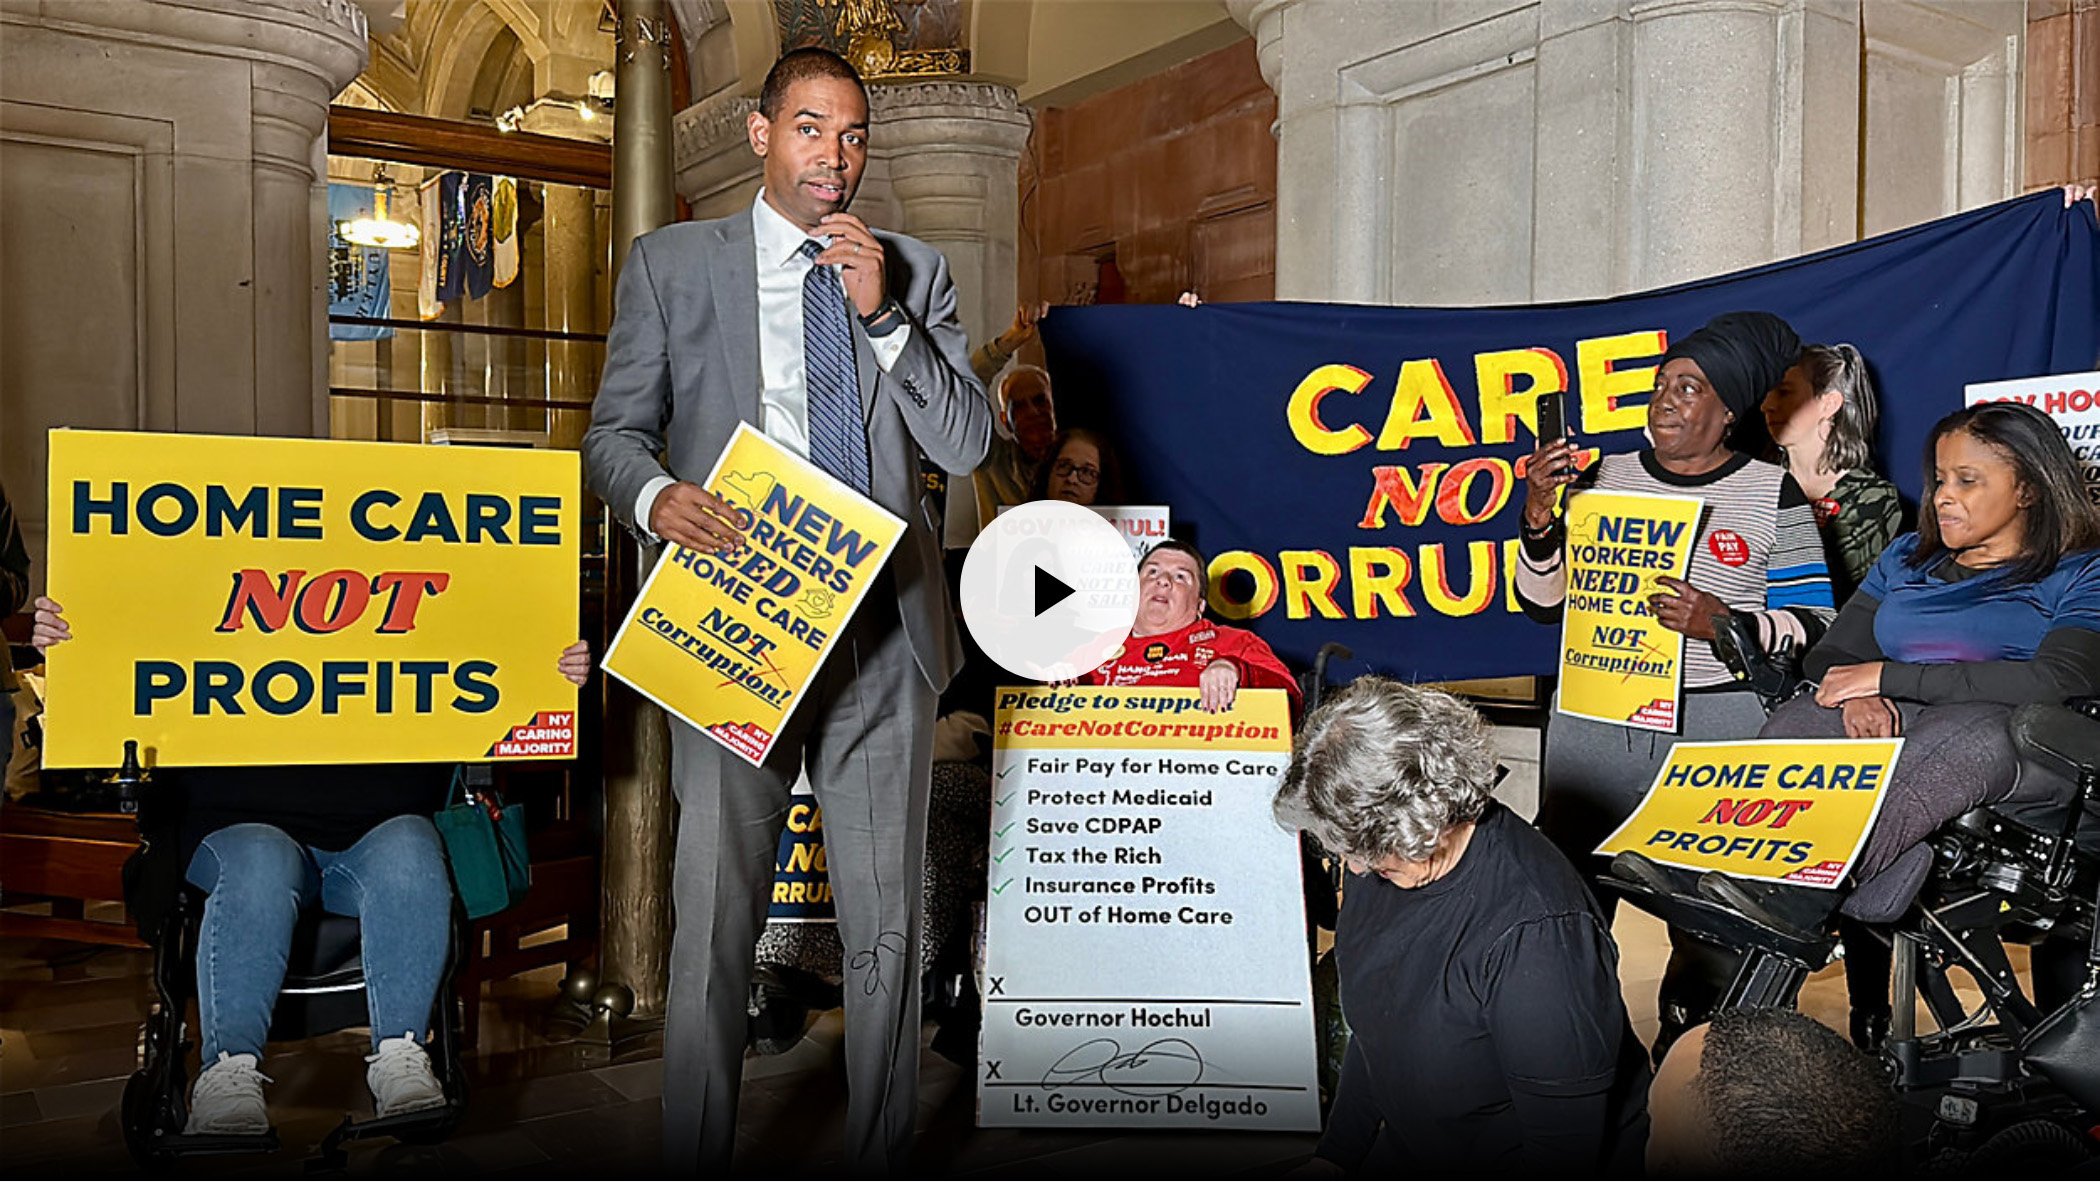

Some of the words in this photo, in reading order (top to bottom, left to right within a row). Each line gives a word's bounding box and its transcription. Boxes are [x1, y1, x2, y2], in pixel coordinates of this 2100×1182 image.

[1286, 329, 1667, 456] CARE
[72, 481, 324, 539] HOME
[350, 490, 561, 545] CARE
[762, 483, 878, 569] NEW
[1597, 515, 1687, 547] NEW
[1714, 533, 1736, 541] FAIR
[715, 490, 853, 594] ORKERS
[1717, 542, 1738, 551] PAY
[1570, 545, 1675, 570] YORKERS
[713, 543, 801, 598] EED
[1570, 569, 1640, 595] NEED
[215, 569, 450, 634] NOT
[673, 546, 754, 606] HOME
[756, 597, 828, 650] CARE
[1568, 594, 1614, 614] HOME
[1619, 600, 1654, 617] CA
[698, 607, 778, 657] NOT
[1592, 625, 1647, 648] NOT
[642, 608, 792, 705] Corruption!
[1565, 648, 1673, 675] Corruption!
[134, 660, 499, 715] PROFITS
[998, 693, 1085, 713] Pledge
[1092, 693, 1119, 710] to
[549, 714, 571, 726] NY
[999, 719, 1279, 741] #CareNotCorruption
[516, 729, 571, 740] CARING
[730, 725, 765, 751] CARING
[753, 729, 769, 741] NY
[500, 742, 571, 755] MAJORITY
[1028, 758, 1070, 774] Fair
[1076, 760, 1115, 778] Pay
[1122, 758, 1152, 775] for
[1158, 759, 1219, 775] Home
[1226, 760, 1279, 777] Care
[1664, 764, 1770, 789] HOME
[1777, 764, 1883, 790] CARE
[1028, 790, 1106, 805] Protect
[1112, 789, 1213, 806] Medicaid
[787, 804, 823, 833] CA
[1699, 798, 1813, 828] NOT
[1026, 818, 1079, 834] Save
[1085, 818, 1162, 834] CDPAP
[1025, 848, 1066, 863] Tax
[1072, 847, 1107, 863] the
[1115, 847, 1162, 864] Rich
[1646, 829, 1814, 864] PROFITS
[1025, 877, 1135, 893] Insurance
[1142, 877, 1216, 894] Profits
[1024, 907, 1072, 924] OUT
[1079, 906, 1102, 924] of
[1108, 907, 1172, 924] Home
[1177, 907, 1233, 925] Care
[988, 977, 1005, 995] X
[1016, 1009, 1125, 1027] Governor
[1131, 1008, 1211, 1027] Hochul
[985, 1061, 1001, 1080] X
[1013, 1094, 1040, 1113] Lt.
[1047, 1094, 1160, 1114] Governor
[1166, 1094, 1268, 1120] Delgado
